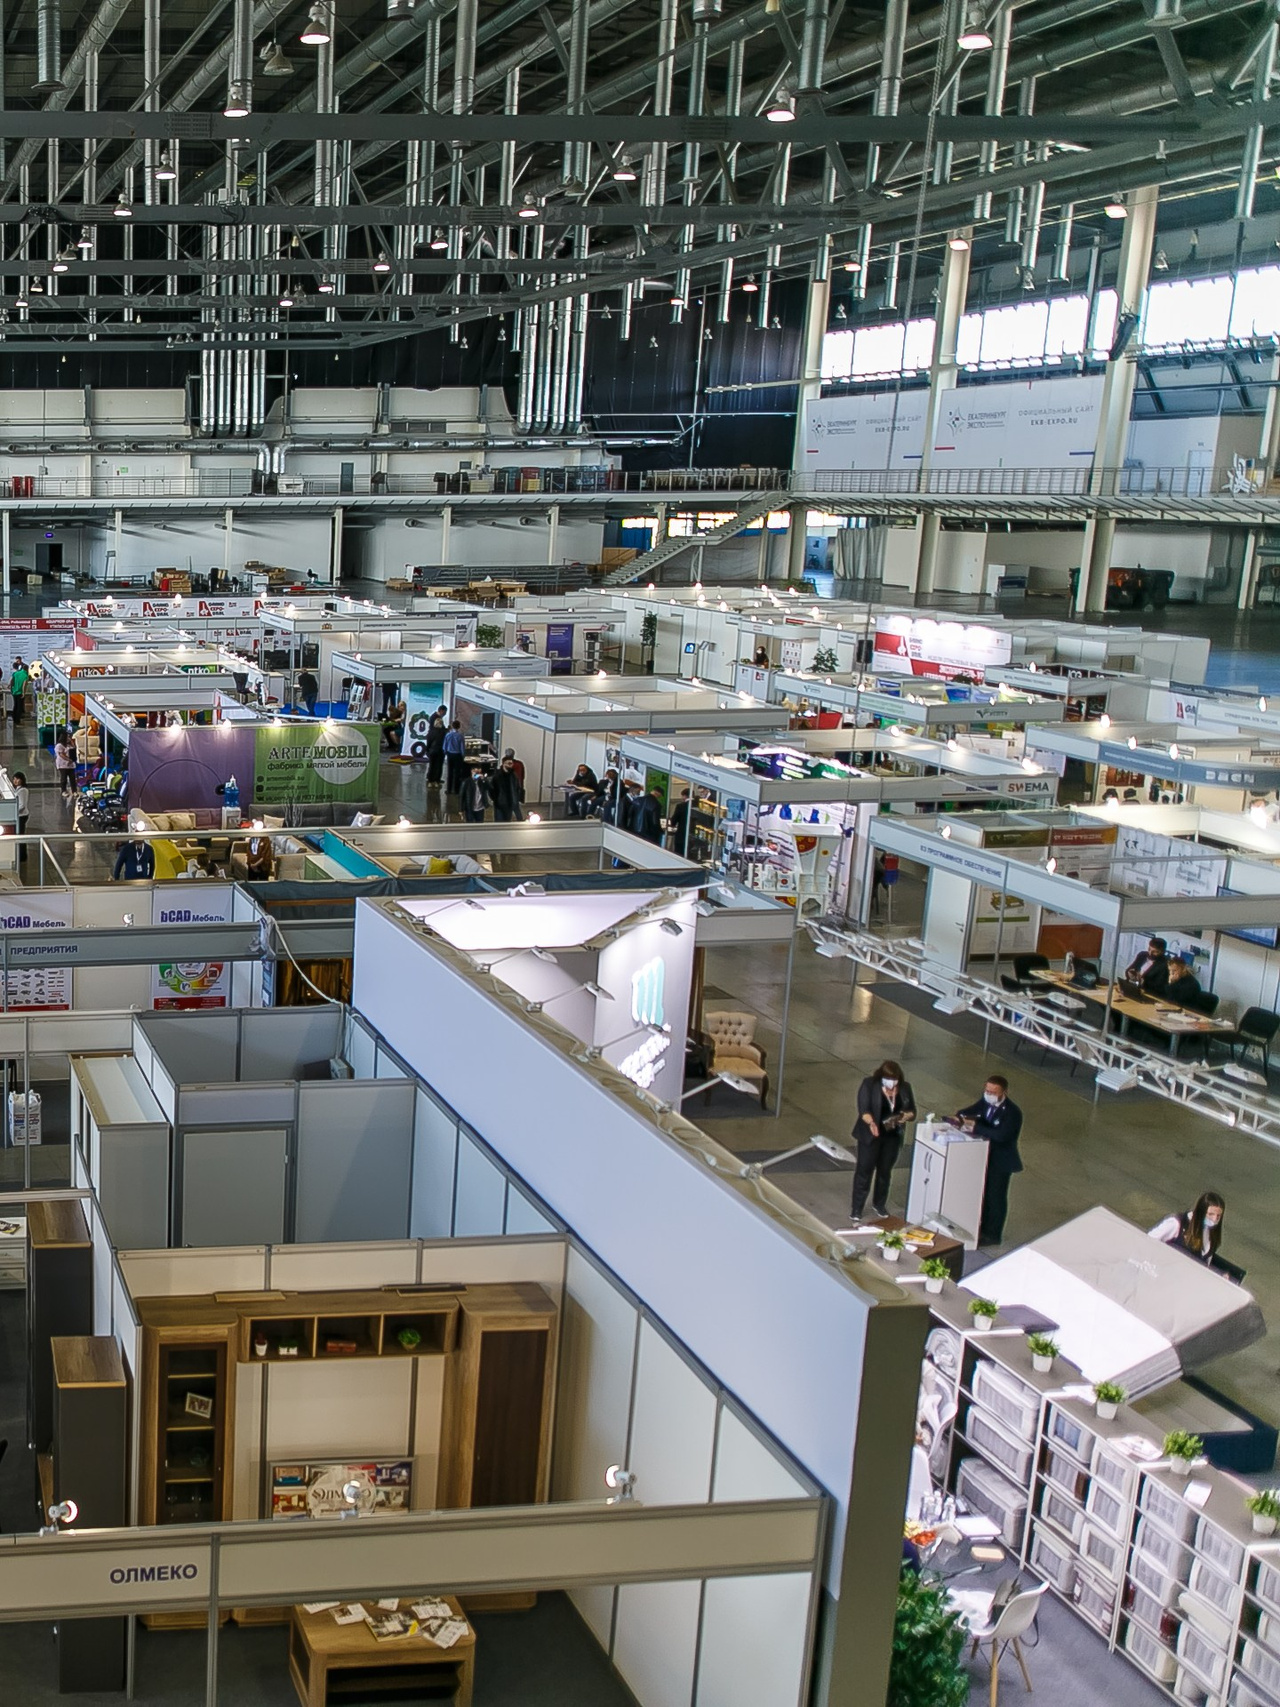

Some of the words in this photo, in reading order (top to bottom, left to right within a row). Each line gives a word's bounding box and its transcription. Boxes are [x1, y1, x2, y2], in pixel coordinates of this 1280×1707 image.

[967, 411, 1007, 421] ЕКАТЕРИНБУРГ
[1018, 408, 1071, 417] ОФИЦИАЛЬНЫЙ
[1074, 405, 1093, 413] САЙТ
[268, 745, 368, 760] ARTEMOBILI
[267, 762, 304, 771] фабрика
[306, 760, 335, 769] мягкой
[337, 759, 368, 768] мебели
[1008, 782, 1049, 792] SWEMA
[0, 916, 31, 929] bCAD
[32, 919, 66, 928] Мебель
[160, 910, 191, 923] bCAD
[192, 914, 225, 923] Мебель
[10, 944, 78, 956] ПРЕДПРИЯТИЯ
[110, 1564, 199, 1585] ОЛМЕКО
